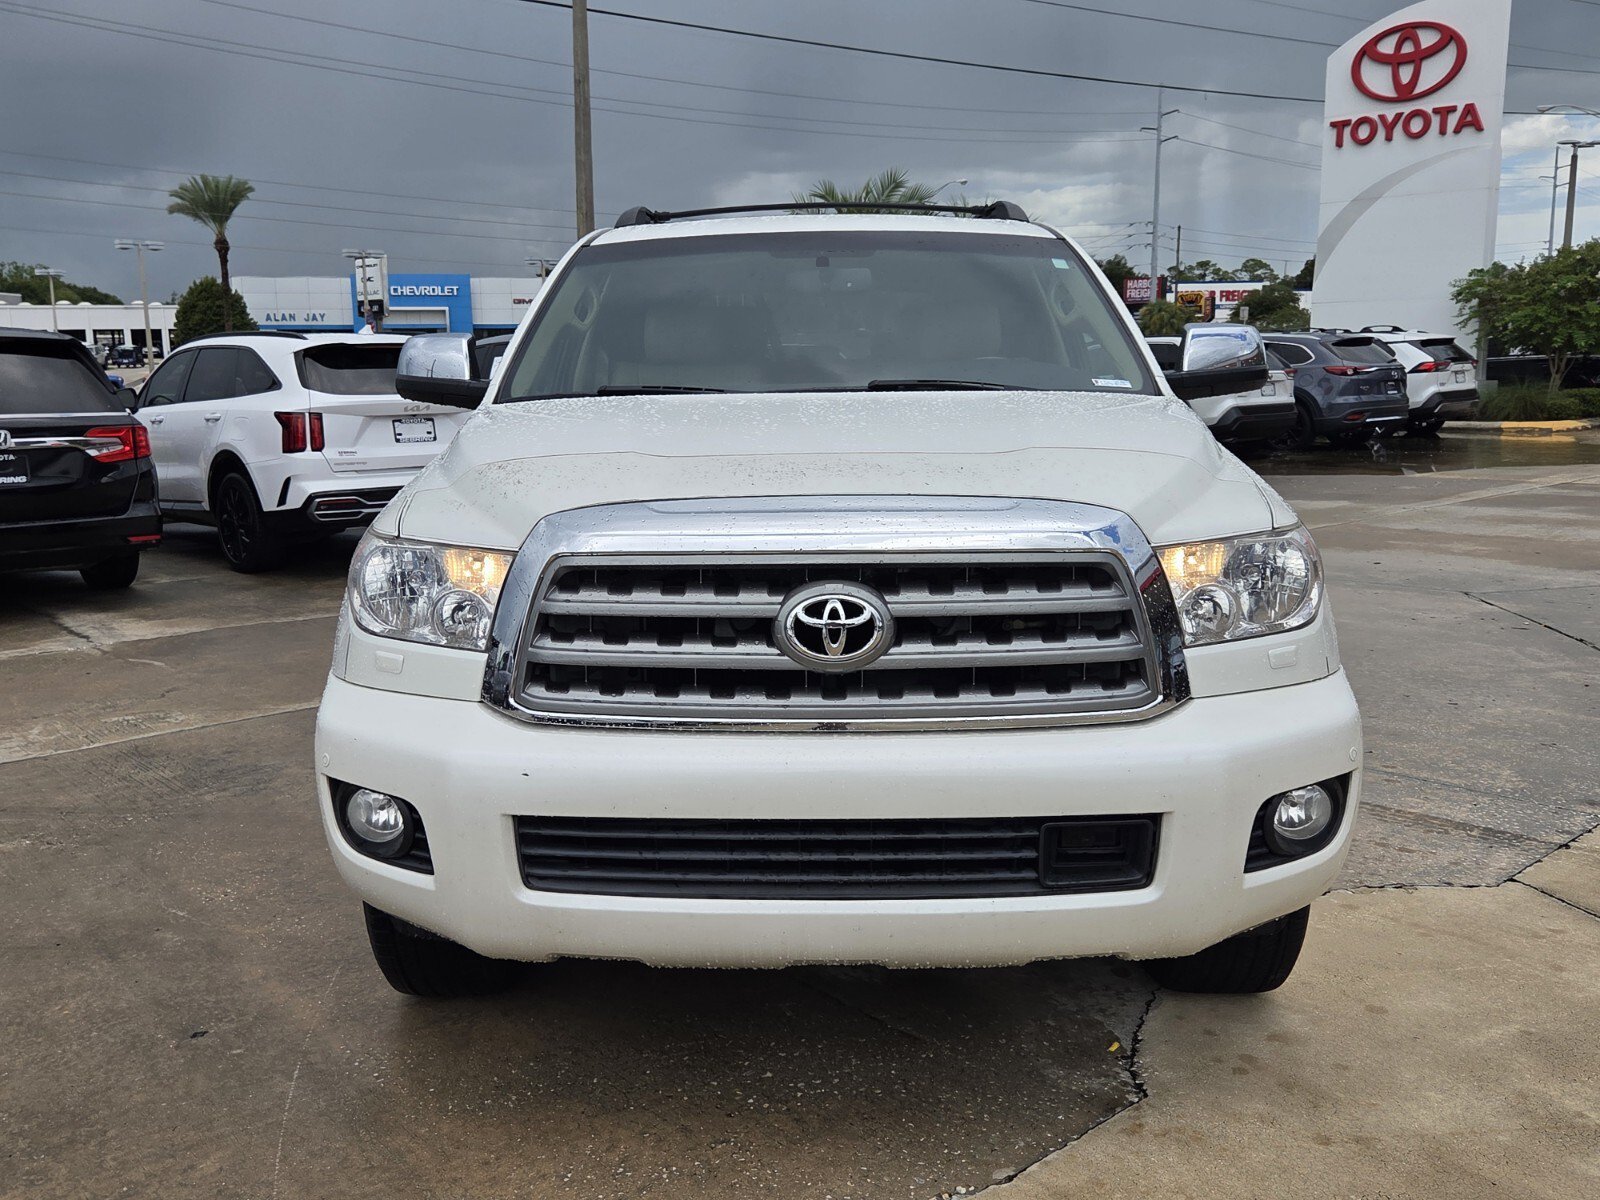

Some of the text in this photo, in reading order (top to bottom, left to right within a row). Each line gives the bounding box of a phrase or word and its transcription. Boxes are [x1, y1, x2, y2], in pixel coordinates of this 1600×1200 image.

[1329, 102, 1485, 149] TOYOTA
[1127, 279, 1152, 289] HARBO
[390, 285, 459, 296] CHEVROLET
[1126, 289, 1150, 298] FREIG
[1219, 289, 1248, 302] FREIG
[265, 312, 326, 322] ALAN JAY
